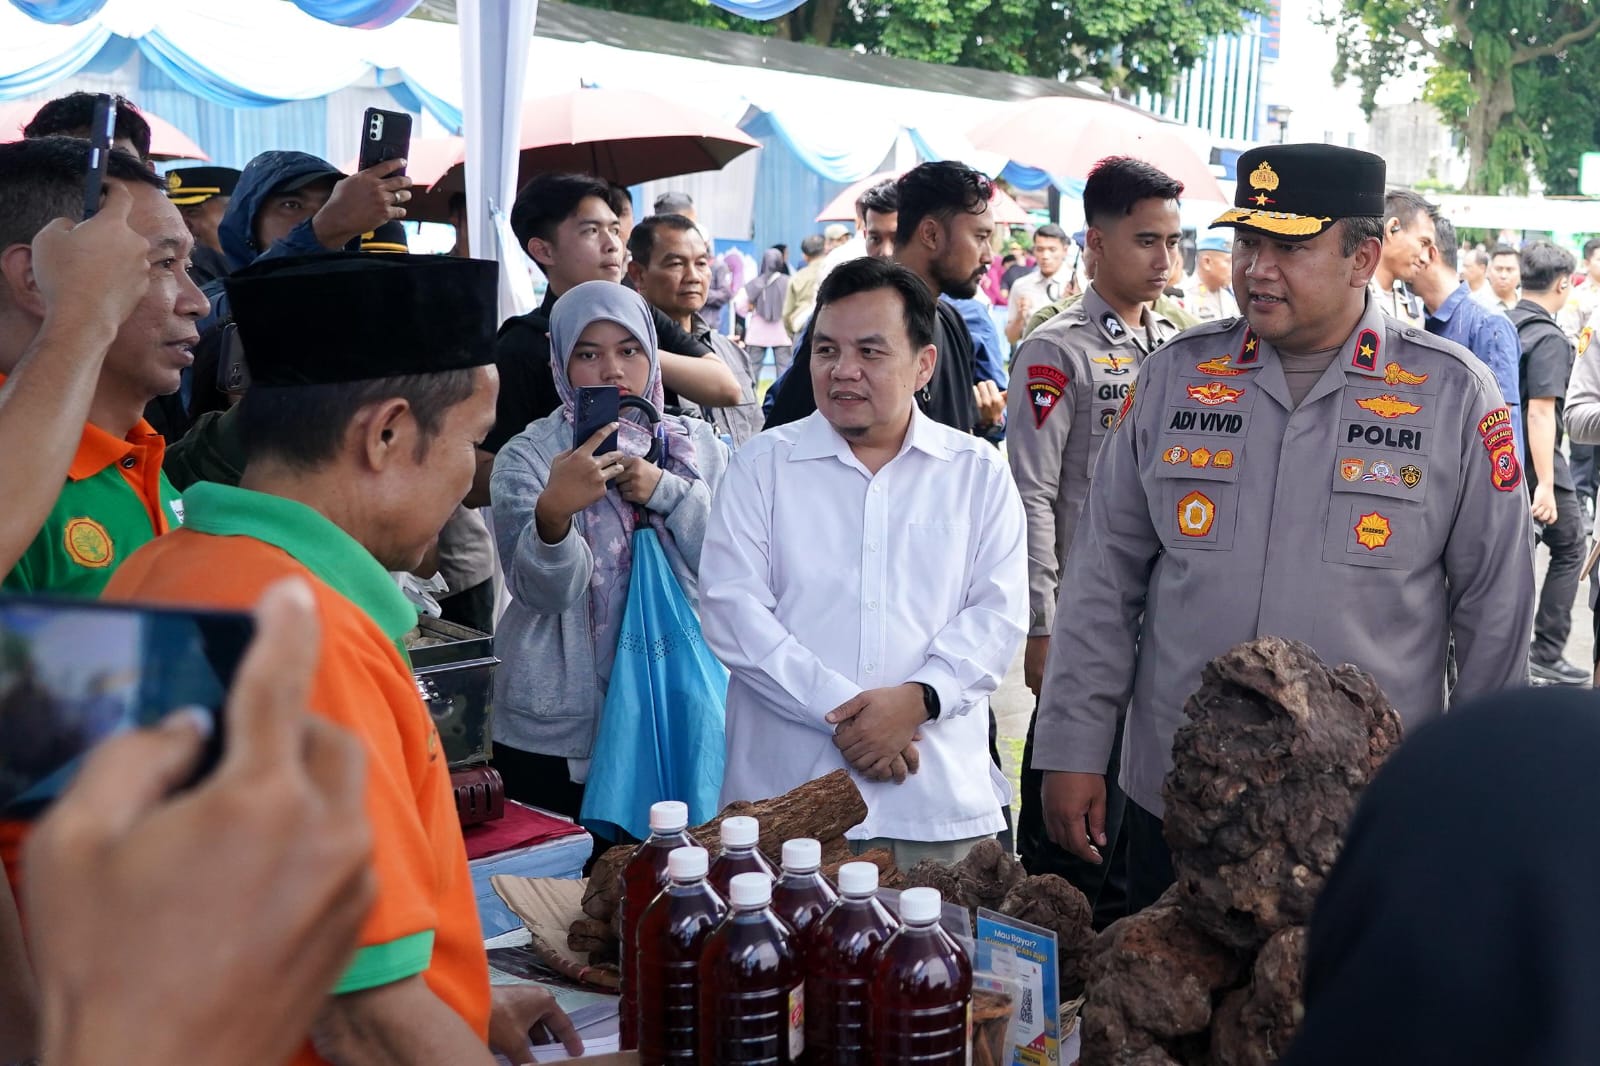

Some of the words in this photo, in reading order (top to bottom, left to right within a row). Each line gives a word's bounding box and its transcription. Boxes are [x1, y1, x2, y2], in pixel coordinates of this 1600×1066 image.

[1169, 411, 1197, 430] ADI
[1200, 412, 1243, 433] VIVID
[1481, 410, 1509, 433] POLDA
[1347, 424, 1422, 450] POLRI
[994, 929, 1011, 940] Mau
[1011, 933, 1037, 948] Bayar?
